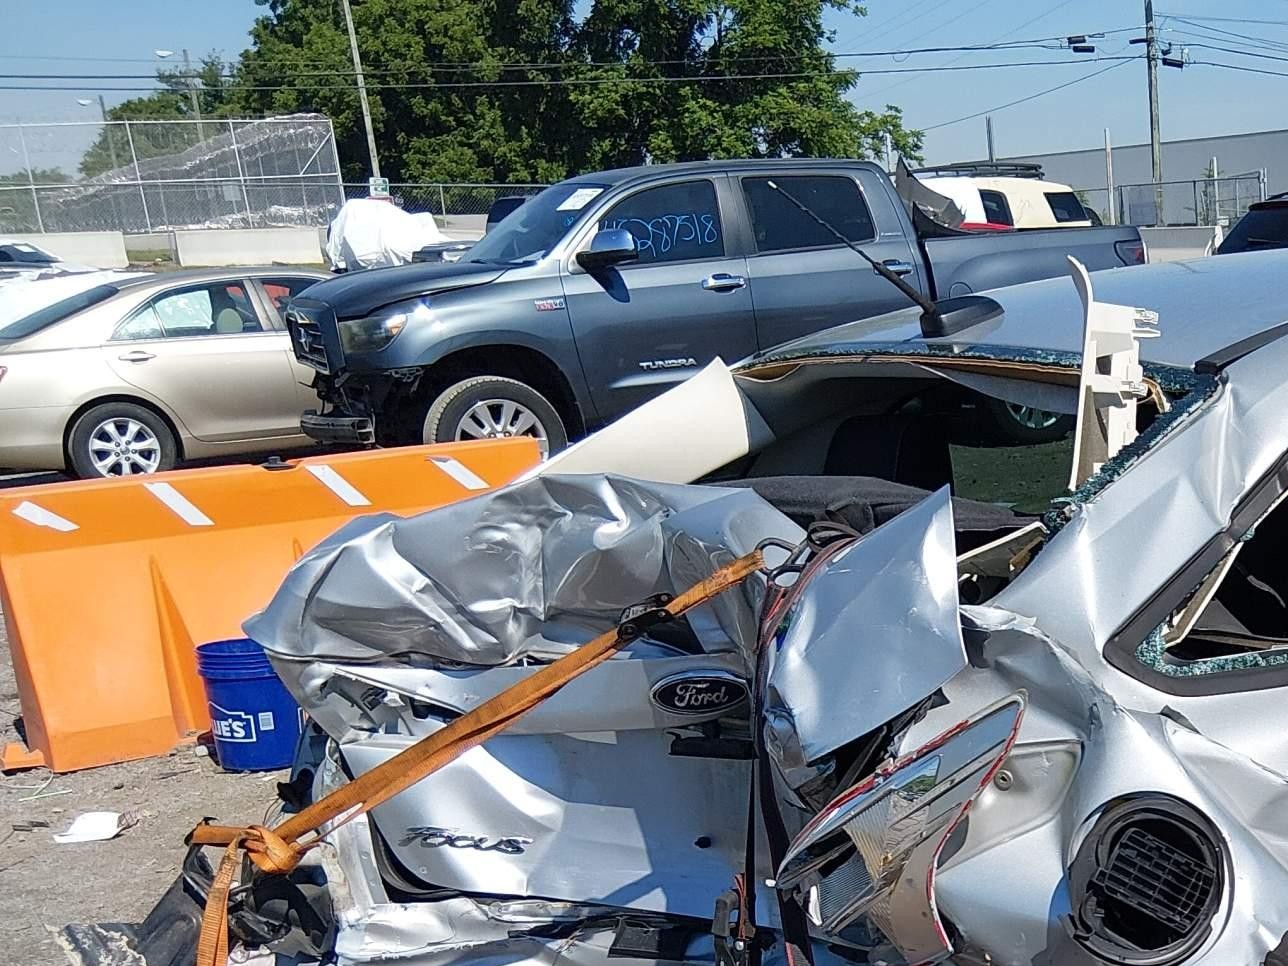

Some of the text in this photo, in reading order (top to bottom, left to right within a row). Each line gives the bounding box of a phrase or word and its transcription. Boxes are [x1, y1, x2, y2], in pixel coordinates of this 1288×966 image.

[604, 213, 718, 257] 287518
[639, 358, 698, 370] TUNDRA
[674, 683, 728, 707] Ford
